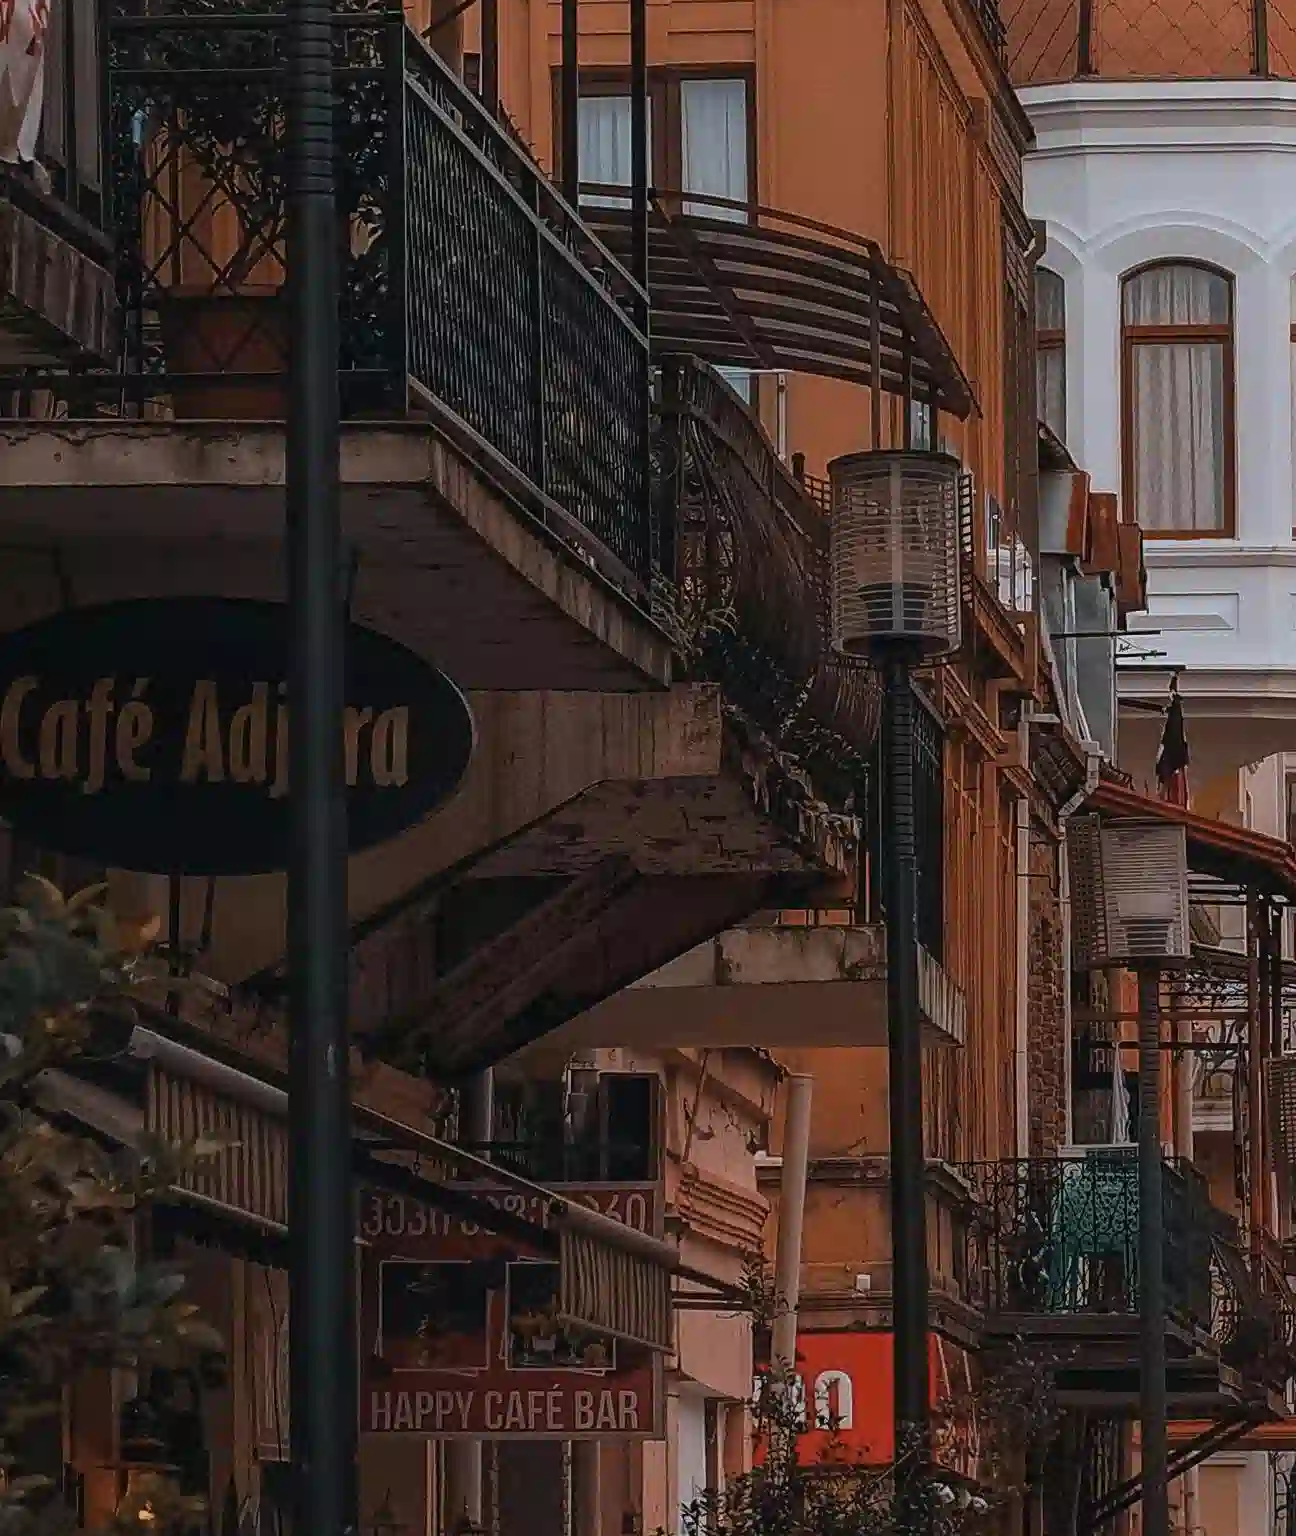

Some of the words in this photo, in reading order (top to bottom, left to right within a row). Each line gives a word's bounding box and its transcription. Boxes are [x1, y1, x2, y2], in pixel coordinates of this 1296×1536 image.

[0, 674, 152, 797] Café
[178, 678, 410, 800] Adjra
[370, 1390, 477, 1431] HAPPY
[483, 1383, 566, 1431] CAFÉ
[573, 1390, 639, 1431] BAR
